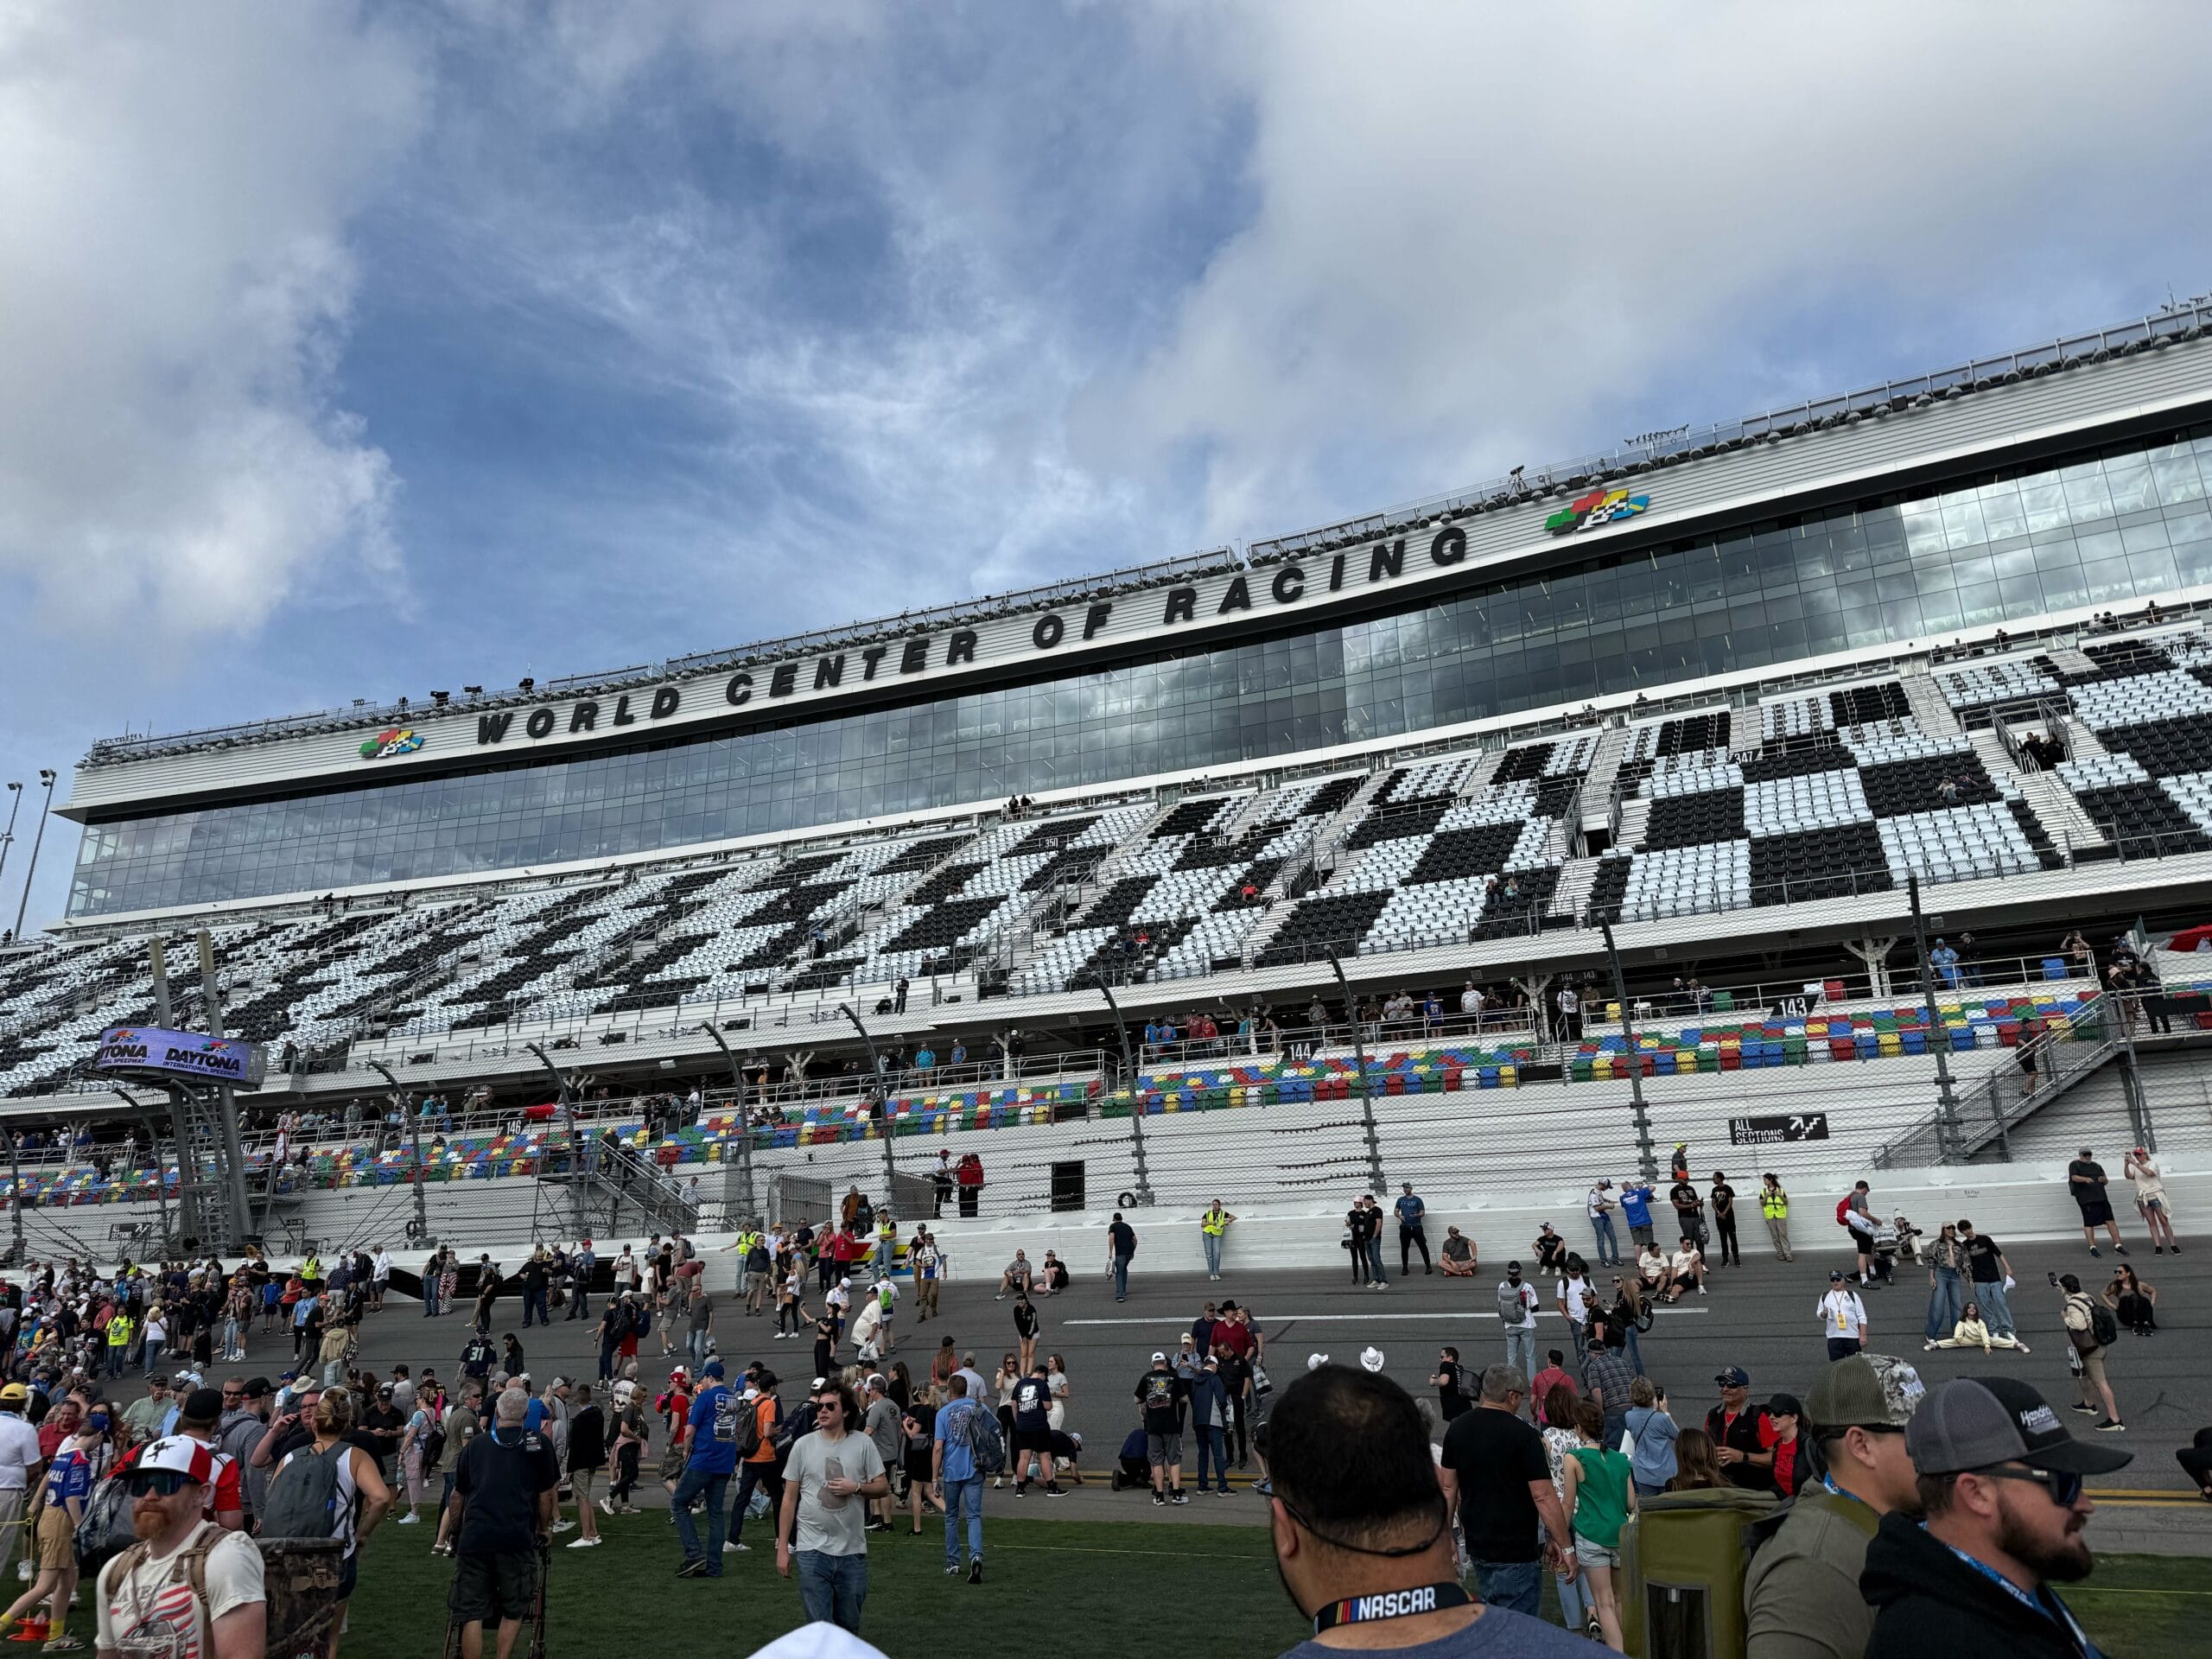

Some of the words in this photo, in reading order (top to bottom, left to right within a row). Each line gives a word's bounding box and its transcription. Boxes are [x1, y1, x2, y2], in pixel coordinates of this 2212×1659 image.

[477, 687, 679, 744] WORLD
[725, 631, 977, 704] CENTER
[1033, 604, 1112, 649] OF
[1164, 527, 1467, 624] RACING
[2164, 644, 2187, 658] 346
[1734, 751, 1753, 764] 347
[1449, 798, 1467, 810] 348
[1045, 837, 1058, 848] 350
[1211, 836, 1227, 848] 349
[1560, 973, 1573, 982] 144
[1583, 970, 1595, 980] 143
[1779, 997, 1808, 1019] 143
[165, 1048, 240, 1071] DAYTONA
[1289, 1042, 1312, 1061] 144
[162, 1061, 208, 1071] INTERNATIONAL
[210, 1068, 239, 1077] SPEEDWAY
[506, 1120, 522, 1135] 146
[1735, 1120, 1753, 1132] ALL
[1735, 1128, 1785, 1145] SECTIONS
[469, 1346, 486, 1362] 31
[1020, 1384, 1036, 1402] 9
[1358, 1586, 1436, 1620] NASCAR
